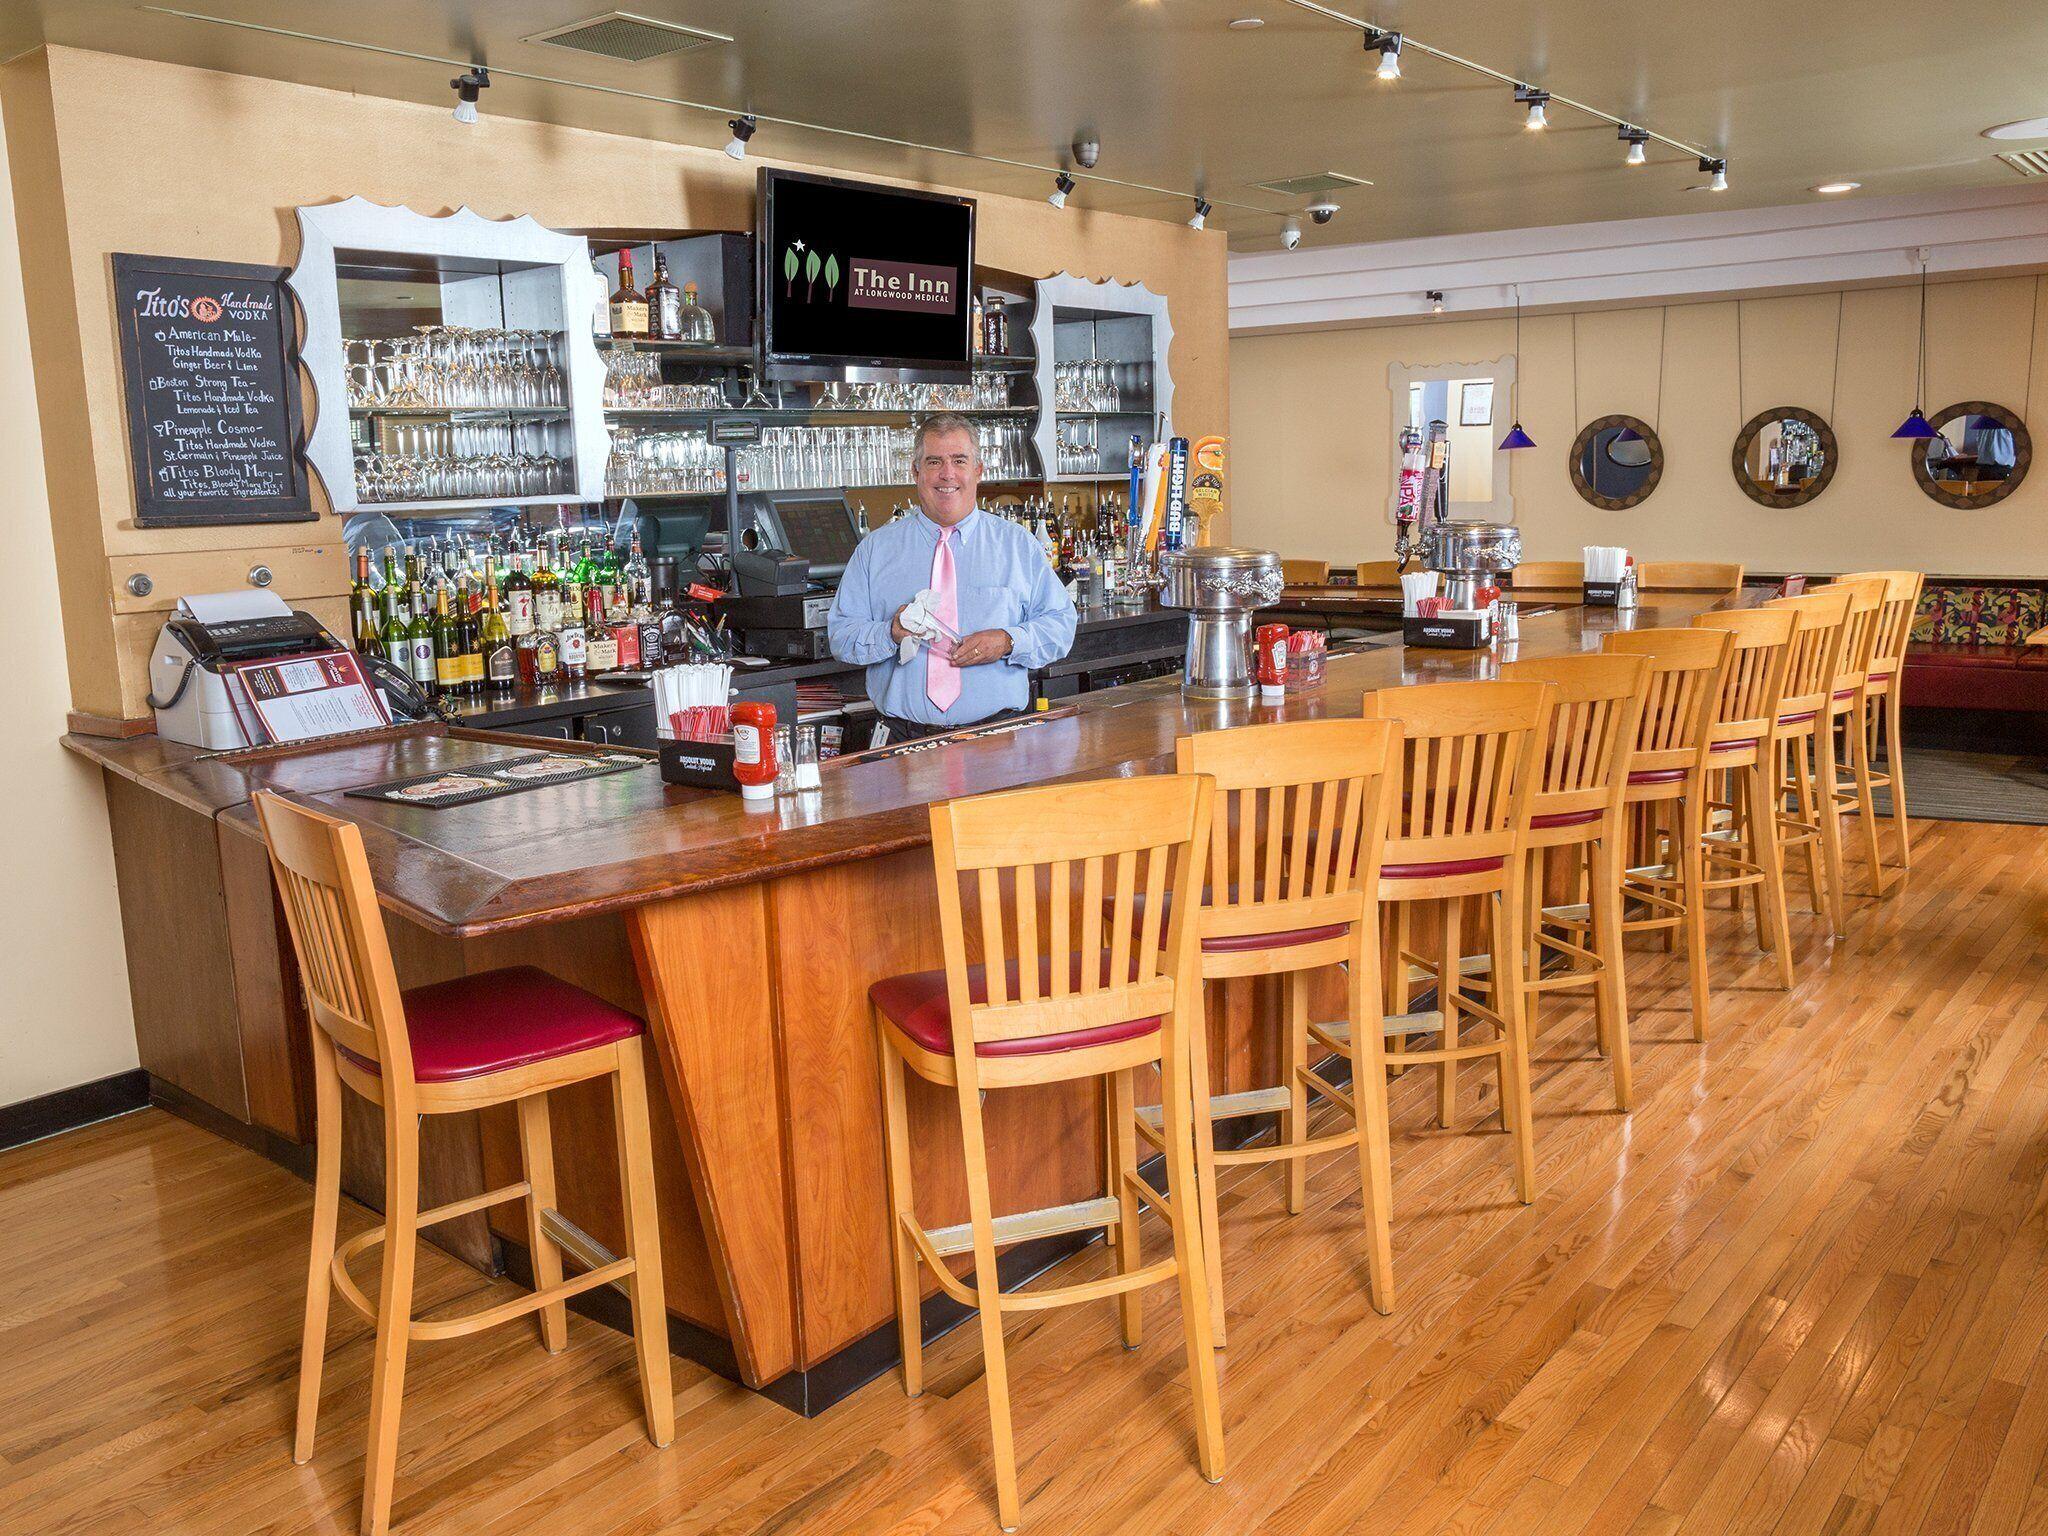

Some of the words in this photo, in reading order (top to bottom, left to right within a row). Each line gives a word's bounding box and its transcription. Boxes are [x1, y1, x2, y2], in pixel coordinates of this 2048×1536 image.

[854, 268, 900, 290] The
[909, 273, 949, 294] Inn
[137, 287, 190, 319] Tito's
[221, 292, 273, 311] Handmade
[854, 288, 864, 296] AT
[866, 289, 912, 300] LONGWOOD
[915, 294, 949, 303] MEDICAL
[229, 310, 269, 321] VODKA
[168, 326, 221, 341] American
[165, 344, 190, 356] Titos
[191, 345, 234, 358] Handmade
[172, 357, 201, 372] Ginger
[204, 358, 225, 370] Beer
[236, 360, 259, 371] Lime
[157, 376, 189, 389] Boston
[195, 374, 228, 391] Strong
[173, 389, 202, 402] Titos
[204, 391, 246, 402] Handmade
[247, 390, 275, 403] Vodka
[177, 404, 216, 414] Lemonade
[224, 404, 240, 414] Iced
[243, 403, 259, 414] Tea
[163, 419, 213, 438] Pineapple
[174, 438, 204, 452] Titos
[205, 437, 248, 450] Handmade
[249, 437, 277, 449] Vodka
[221, 451, 258, 463] Pineapple
[260, 450, 284, 461] Juice
[167, 465, 200, 479] Titos
[202, 463, 241, 481] Bloody
[1171, 453, 1185, 499] LIGHT
[212, 478, 239, 490] Bloody
[241, 479, 261, 490] Mary
[163, 488, 176, 497] all
[177, 490, 195, 499] your
[198, 489, 229, 497] favorite
[1169, 500, 1182, 532] BUD
